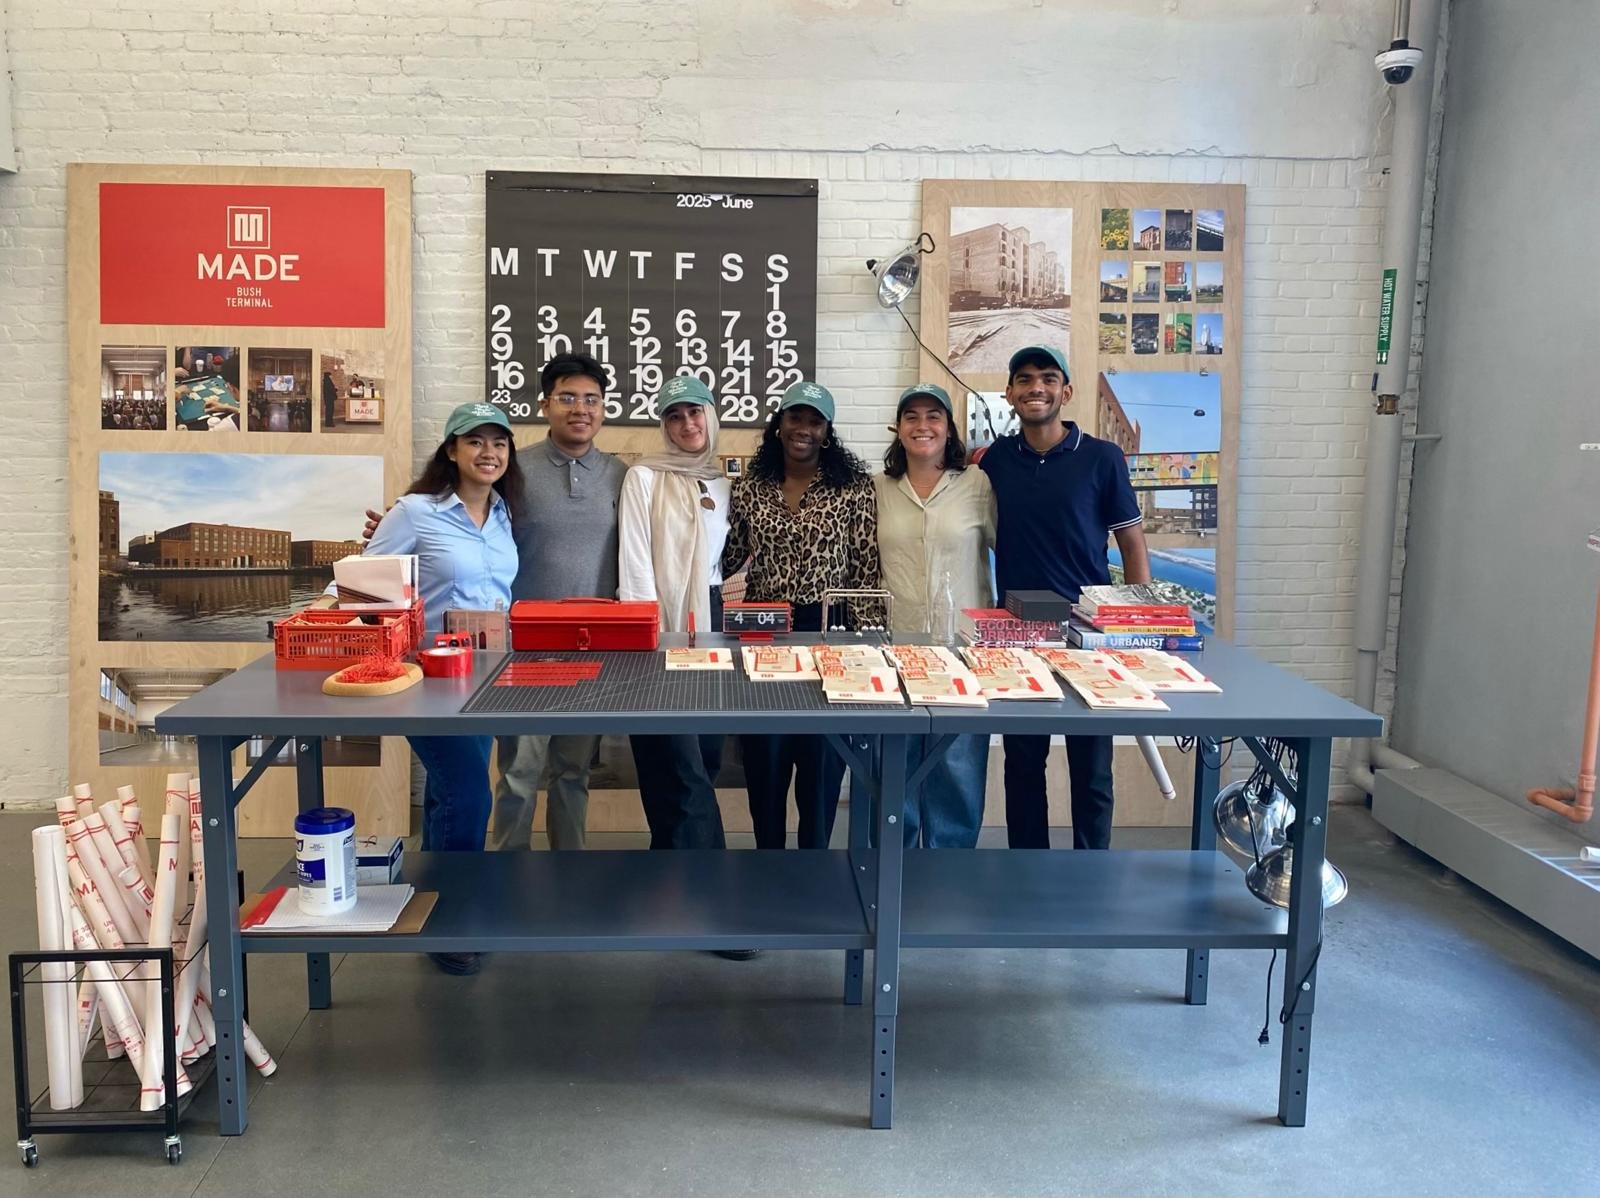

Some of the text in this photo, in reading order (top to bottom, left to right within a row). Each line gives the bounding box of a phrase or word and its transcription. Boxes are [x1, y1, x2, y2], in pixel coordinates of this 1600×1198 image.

[676, 193, 754, 209] 2025 June
[197, 252, 300, 281] MADE
[490, 247, 789, 283] M T W T F S S
[236, 286, 262, 297] BUSH
[766, 283, 780, 311] 1
[226, 297, 273, 308] TERMINAL
[1379, 277, 1393, 342] HOT WATER SUPPLY
[491, 304, 787, 338] 2 3 4 5 6 7 8
[490, 332, 798, 367] 9 10 11 12 13 14 15
[491, 361, 525, 390] 16
[600, 363, 617, 391] 8
[629, 364, 663, 393] 19
[721, 367, 750, 394] 21
[491, 389, 511, 403] 23
[509, 403, 531, 418] 30
[604, 392, 623, 419] 5
[721, 395, 759, 422] 28
[734, 611, 744, 625] 4
[757, 611, 775, 625] 04
[979, 619, 1060, 631] ECOLOGICAL
[979, 630, 1047, 641] URBANISM
[1110, 637, 1165, 648] URBANIST
